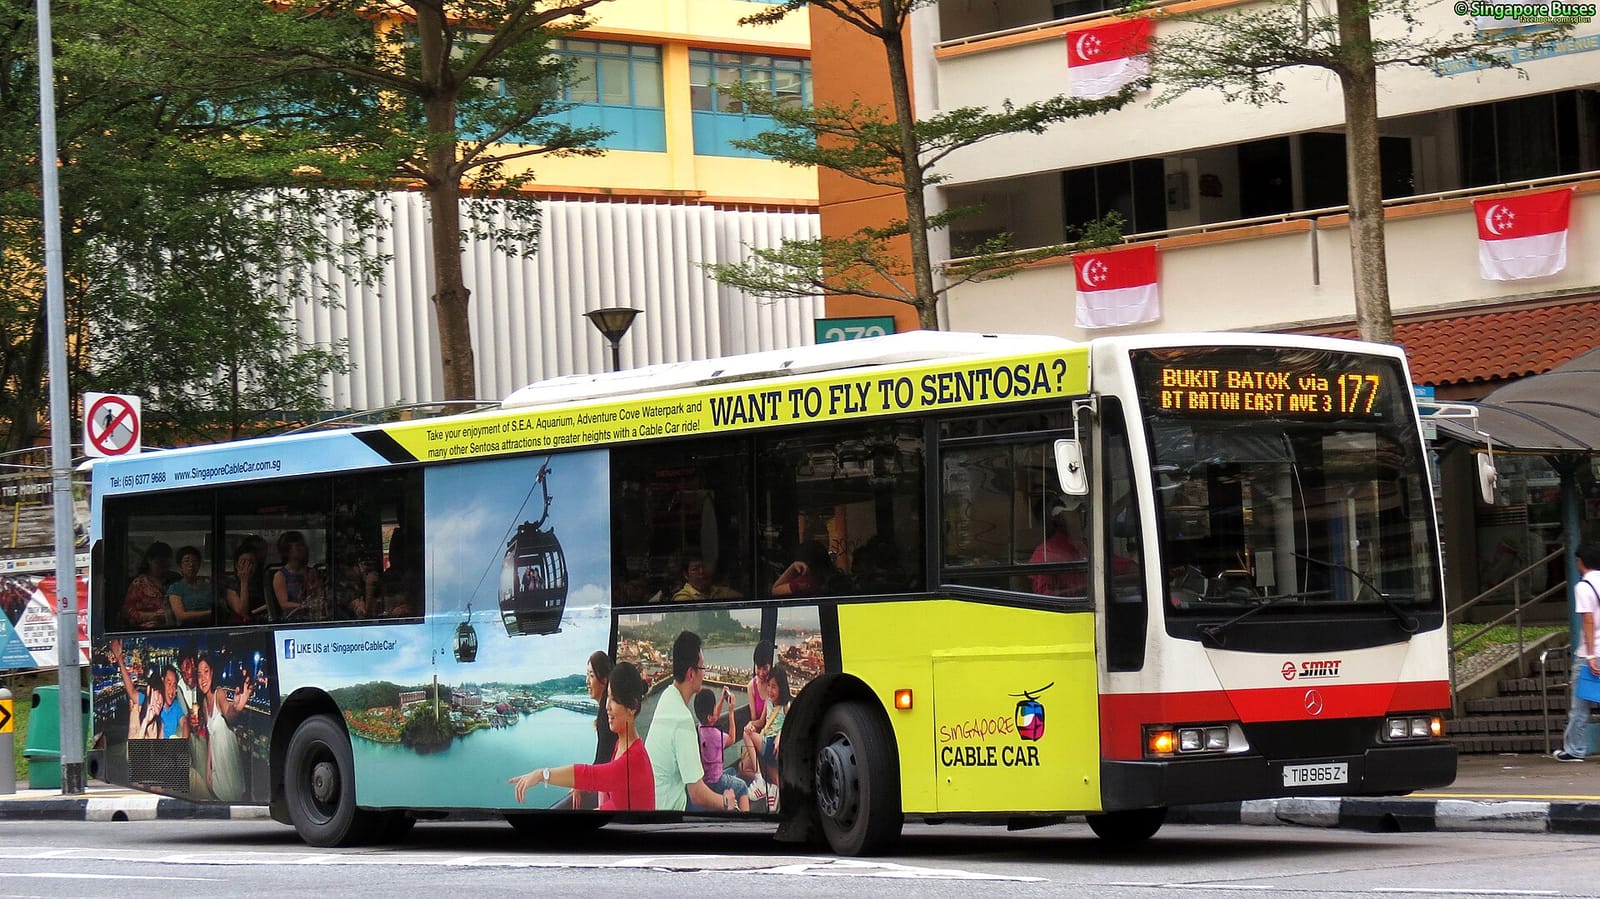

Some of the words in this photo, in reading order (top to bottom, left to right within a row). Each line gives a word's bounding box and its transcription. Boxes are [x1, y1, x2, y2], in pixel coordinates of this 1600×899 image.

[1162, 368, 1220, 389] BUKIT
[1227, 370, 1291, 391] BATOK
[1298, 373, 1329, 392] via
[710, 391, 782, 426] WANT
[788, 386, 822, 418] TO
[829, 381, 871, 414] FLY
[878, 376, 914, 409] TO
[920, 358, 1067, 406] SENTOSA?
[1161, 390, 1184, 410] BT
[1188, 391, 1241, 411] BATOK
[1244, 393, 1285, 412] EAST
[1289, 394, 1319, 413] AVE
[1322, 397, 1332, 413] 3
[1337, 374, 1380, 414] 177
[427, 429, 444, 441] Take
[445, 429, 461, 441] your
[462, 424, 501, 439] enjoyment
[502, 421, 511, 433] of
[511, 418, 535, 432] S.E.A.
[536, 413, 576, 429] Aquarium,
[576, 412, 618, 425] Adventure
[618, 408, 641, 421] Cove
[641, 402, 684, 418] Waterpark
[686, 400, 703, 413] and
[428, 446, 448, 459] many
[449, 444, 469, 456] other
[470, 441, 501, 454] Sentosa
[501, 436, 542, 451] attractions
[543, 435, 552, 446] to
[552, 433, 581, 448] greater
[582, 428, 611, 444] heights
[613, 426, 631, 439] with
[632, 427, 637, 437] a
[639, 422, 663, 437] Cable
[664, 421, 680, 434] Car
[681, 419, 701, 432] ride!
[110, 477, 121, 488] Tel:
[122, 476, 135, 488] (65)
[135, 474, 150, 486] 6377
[151, 472, 166, 484] 9688
[174, 459, 282, 481] www.SingaporeCableCar.com.sg
[2, 486, 19, 497] THE
[20, 482, 53, 496] MOMENT
[296, 643, 312, 654] LIKE
[313, 643, 322, 653] US
[323, 643, 330, 652] at
[1299, 660, 1342, 677] SMRT
[940, 716, 1014, 742] SINGAPORE
[941, 746, 997, 767] CABLE
[1002, 746, 1040, 767] CAR
[1292, 766, 1341, 783] TIB965Z
